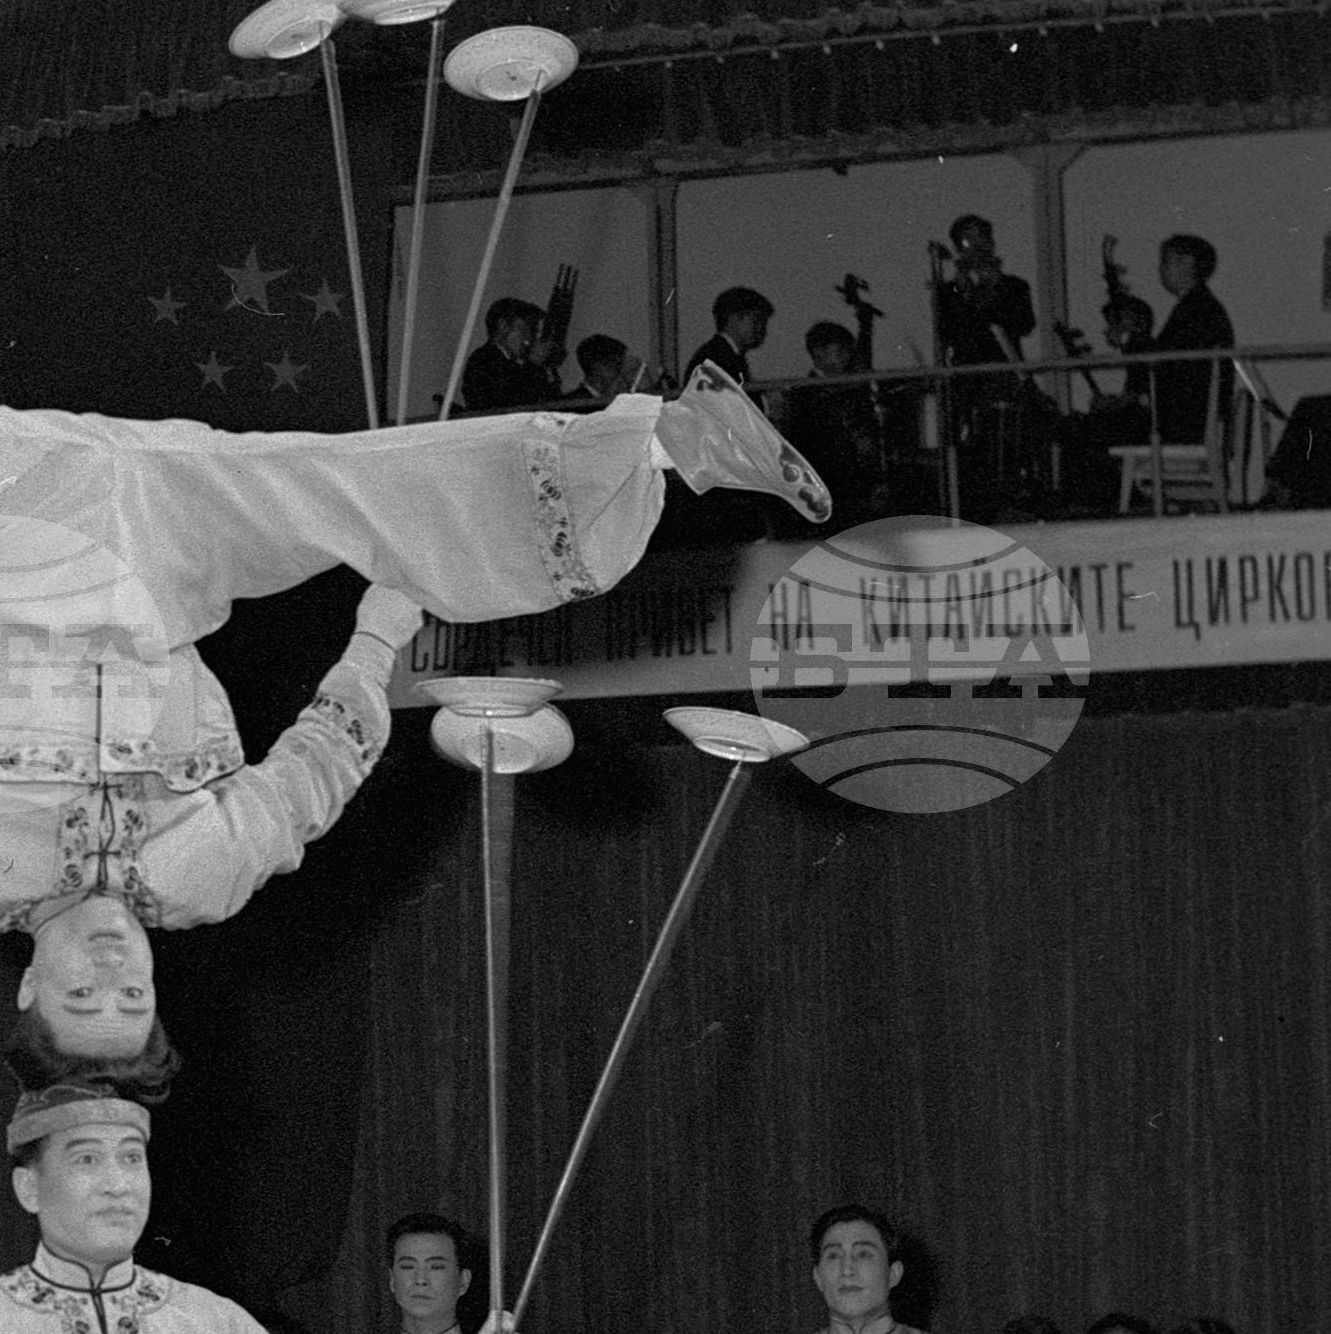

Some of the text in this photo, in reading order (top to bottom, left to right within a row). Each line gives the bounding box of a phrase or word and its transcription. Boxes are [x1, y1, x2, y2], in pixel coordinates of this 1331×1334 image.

[606, 582, 734, 661] ПРИВЕТ
[769, 579, 815, 652] НА
[859, 558, 1137, 645] КИТАЙСКИТЕ
